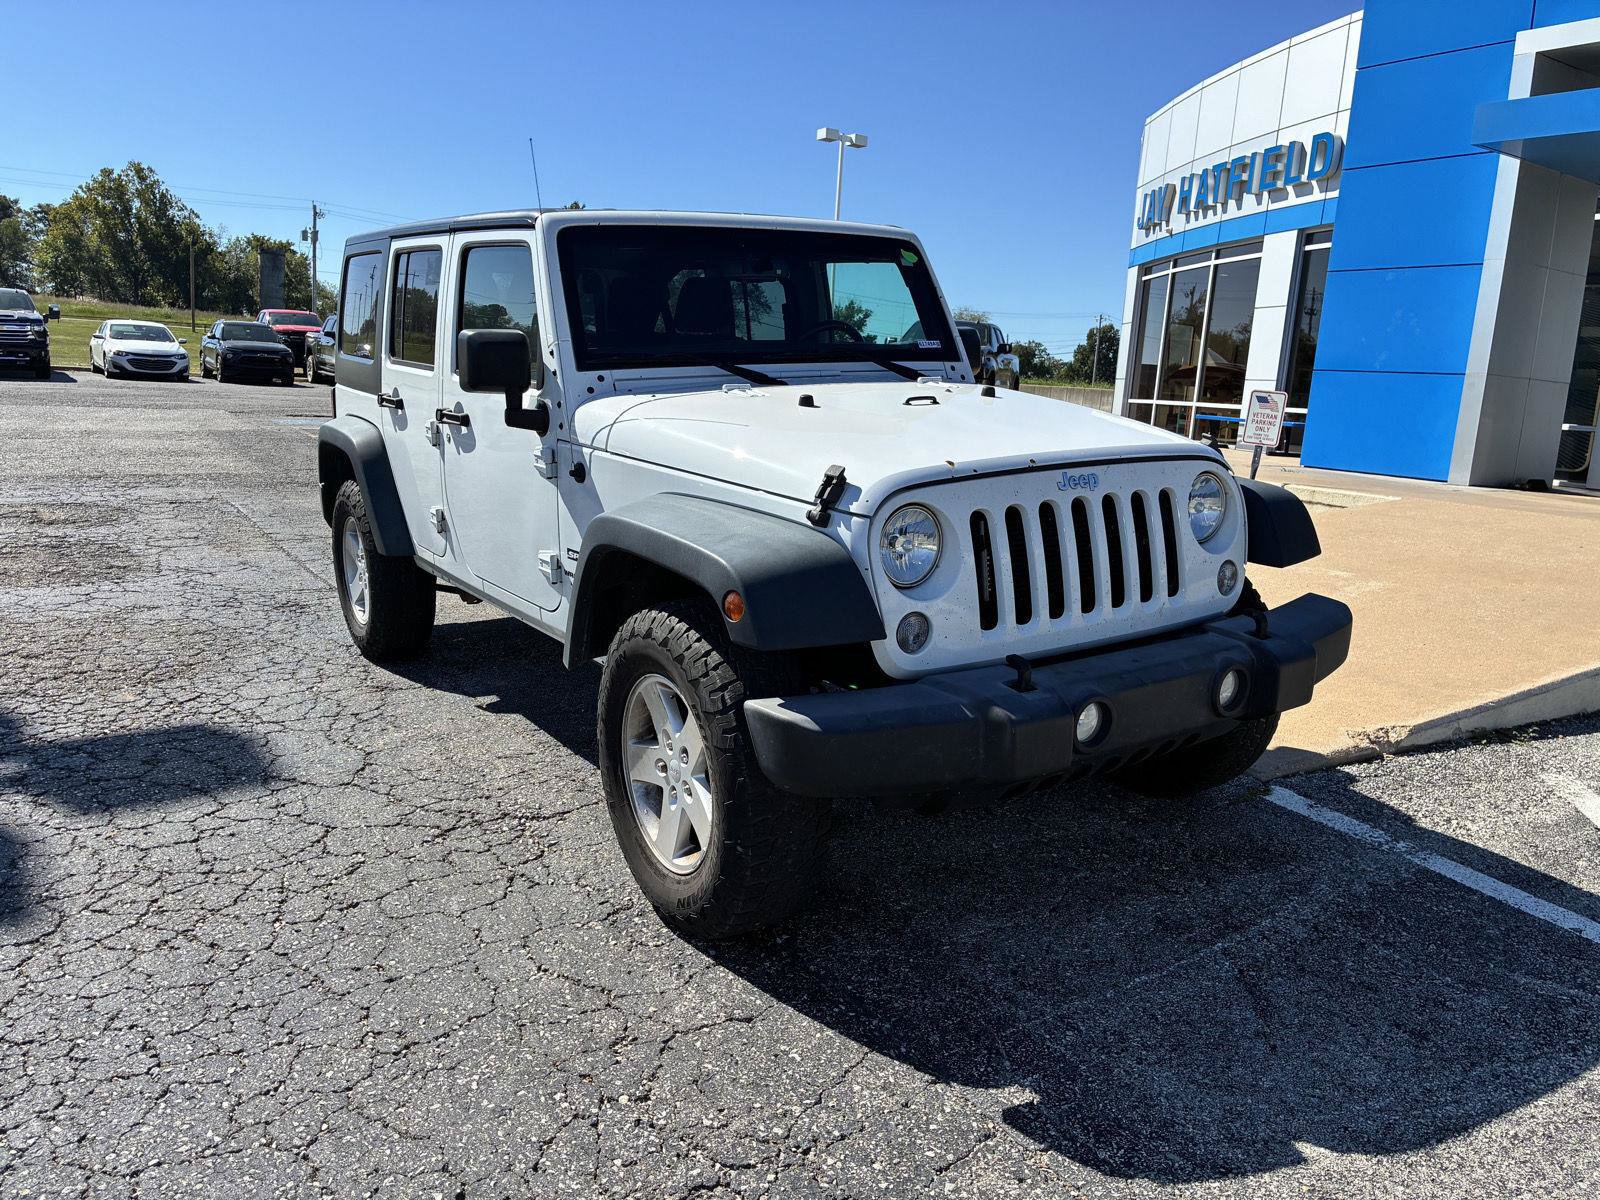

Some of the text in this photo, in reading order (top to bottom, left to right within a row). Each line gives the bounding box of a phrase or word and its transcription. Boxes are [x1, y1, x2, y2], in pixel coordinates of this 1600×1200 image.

[1137, 132, 1343, 230] JAY HATFIELD
[1252, 418, 1277, 427] PARKING
[1253, 412, 1278, 420] VETERAN
[1056, 471, 1099, 491] Jeep
